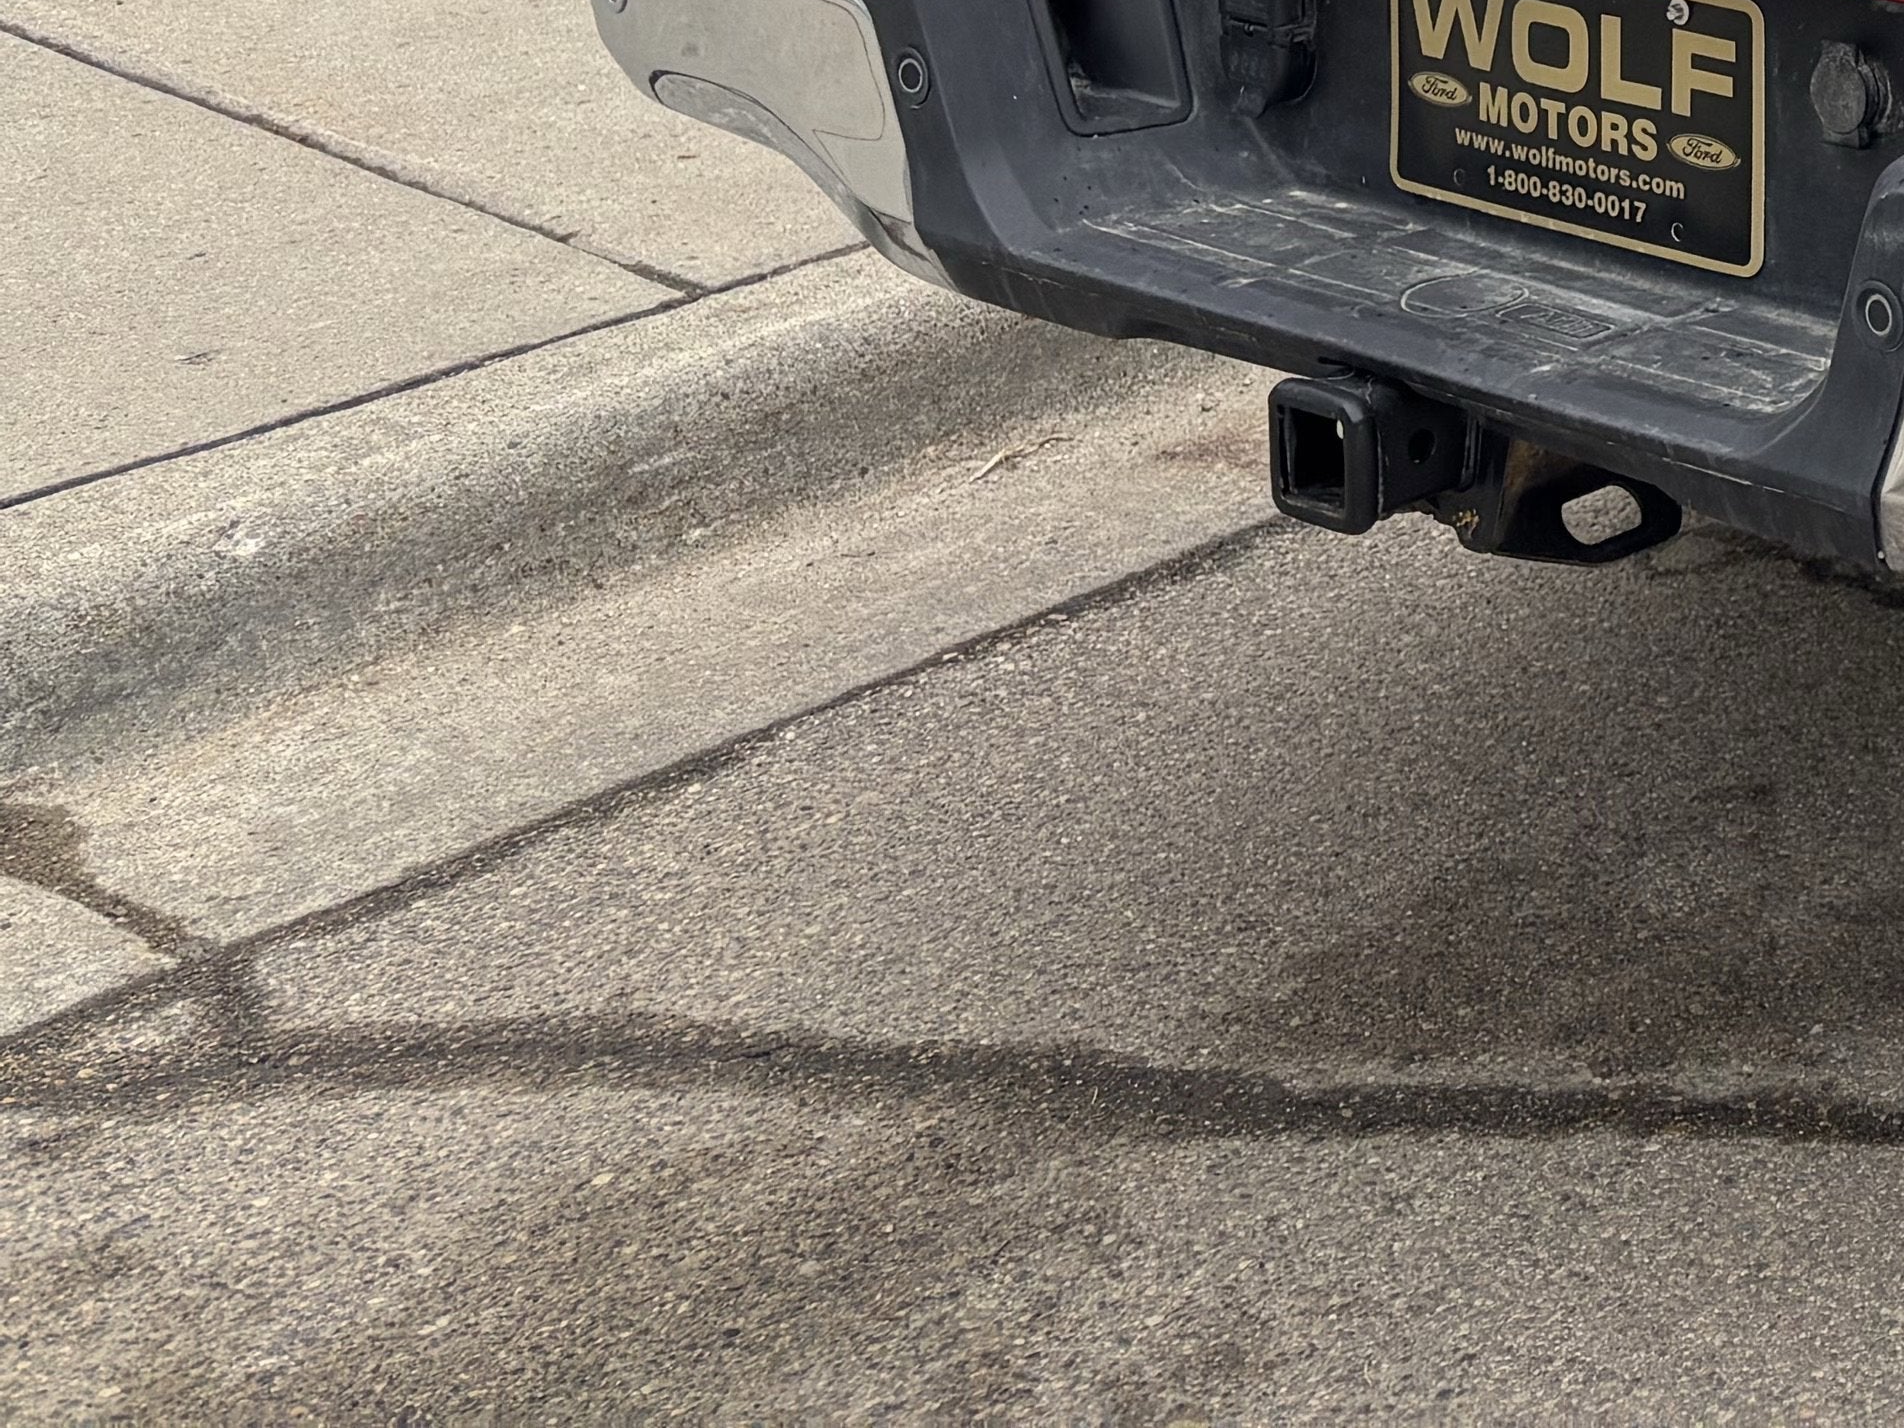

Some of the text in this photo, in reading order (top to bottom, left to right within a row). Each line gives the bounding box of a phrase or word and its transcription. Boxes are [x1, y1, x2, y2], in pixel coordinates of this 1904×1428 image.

[1478, 82, 1658, 162] MOTORS
[1455, 128, 1685, 200] www.wolfmotors.com
[1487, 165, 1647, 223] 1-800-830-0017
